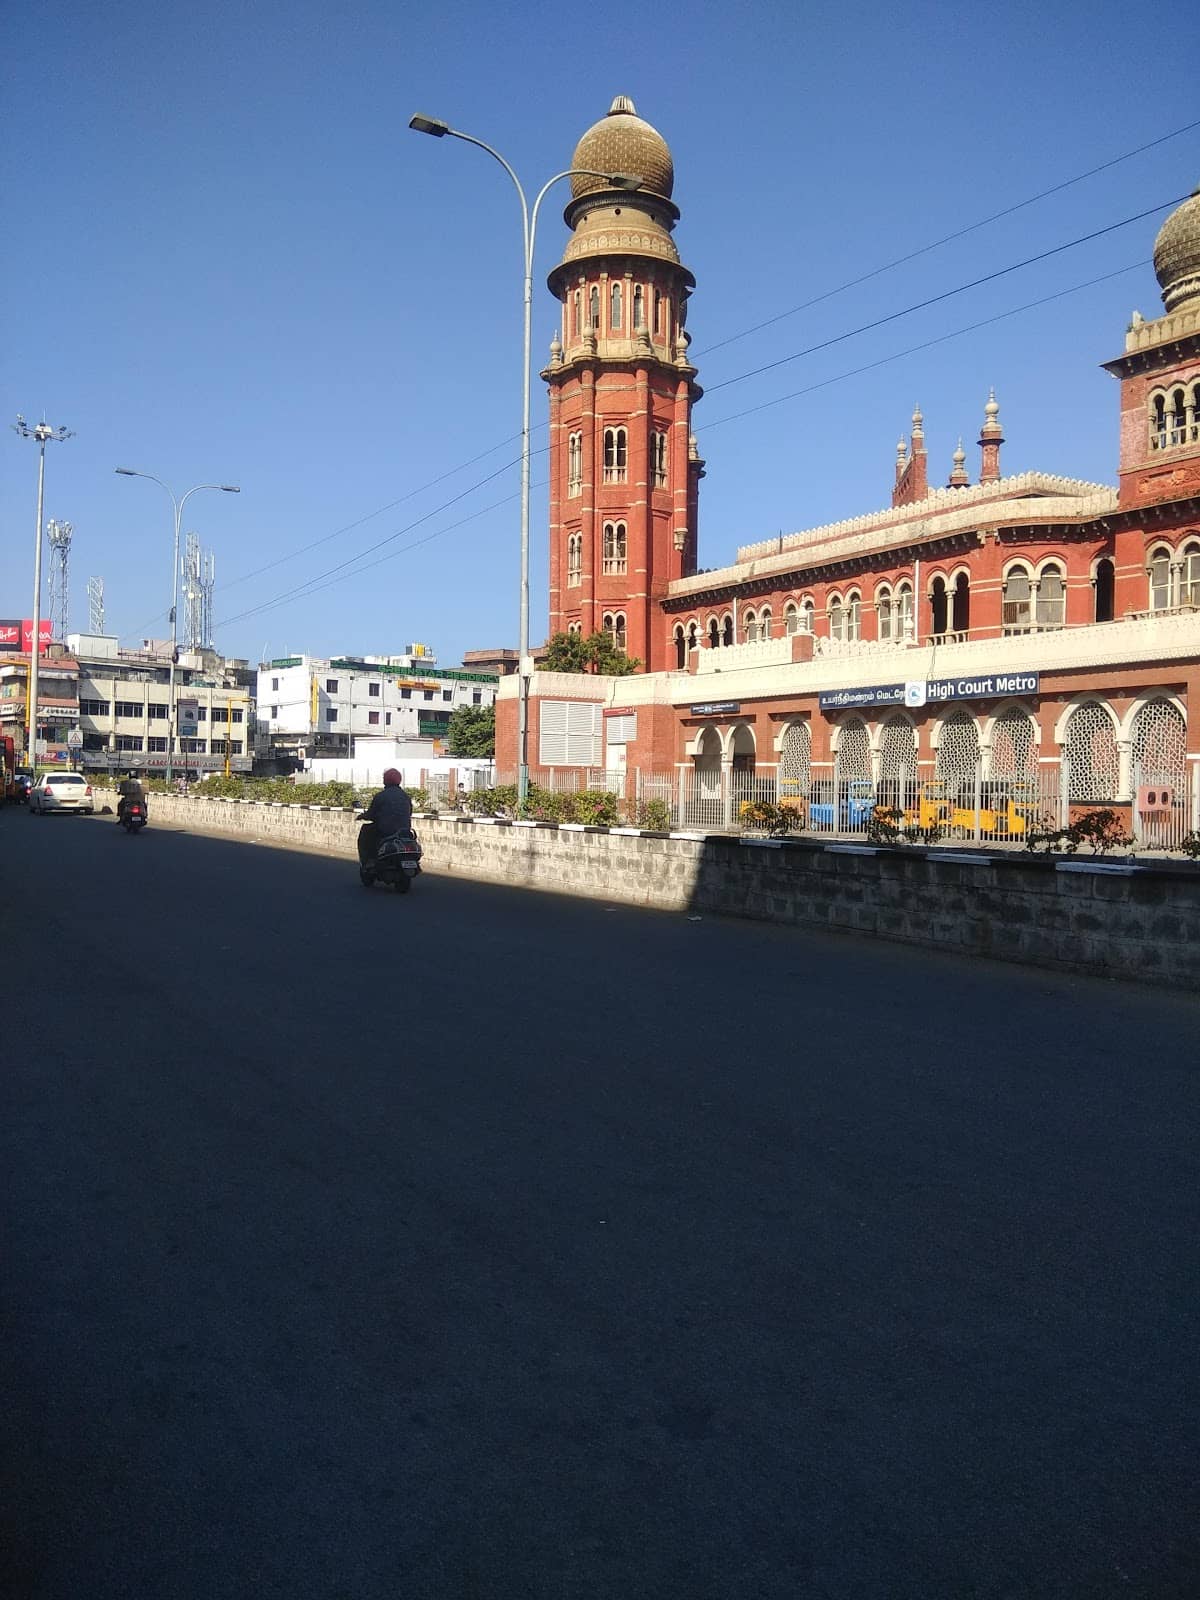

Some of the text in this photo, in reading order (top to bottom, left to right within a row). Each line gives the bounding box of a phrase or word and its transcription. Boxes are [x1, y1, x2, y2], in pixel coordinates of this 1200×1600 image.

[377, 665, 500, 683] GREENSTAR RESIDENCY
[927, 676, 1036, 700] High Court Metro
